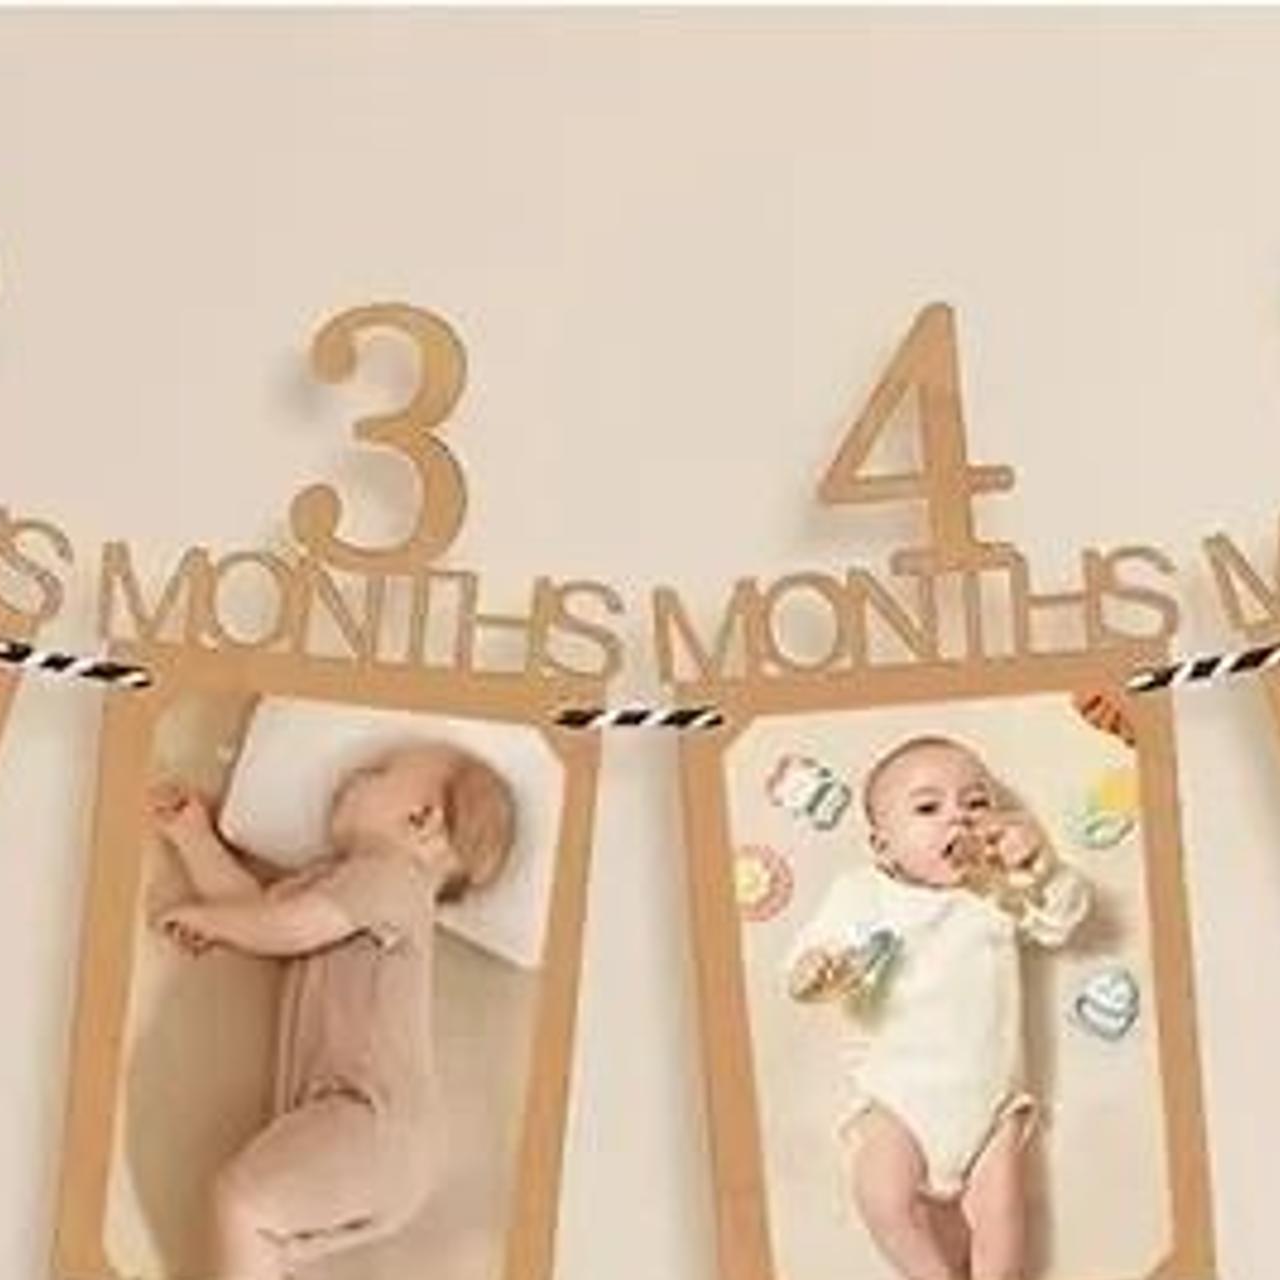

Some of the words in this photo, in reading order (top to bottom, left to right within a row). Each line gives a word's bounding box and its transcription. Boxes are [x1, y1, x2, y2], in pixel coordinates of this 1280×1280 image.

[290, 302, 468, 572] 3
[817, 302, 1014, 573] 4
[100, 542, 623, 681] MONTHS
[654, 546, 1180, 683] MONTHS
